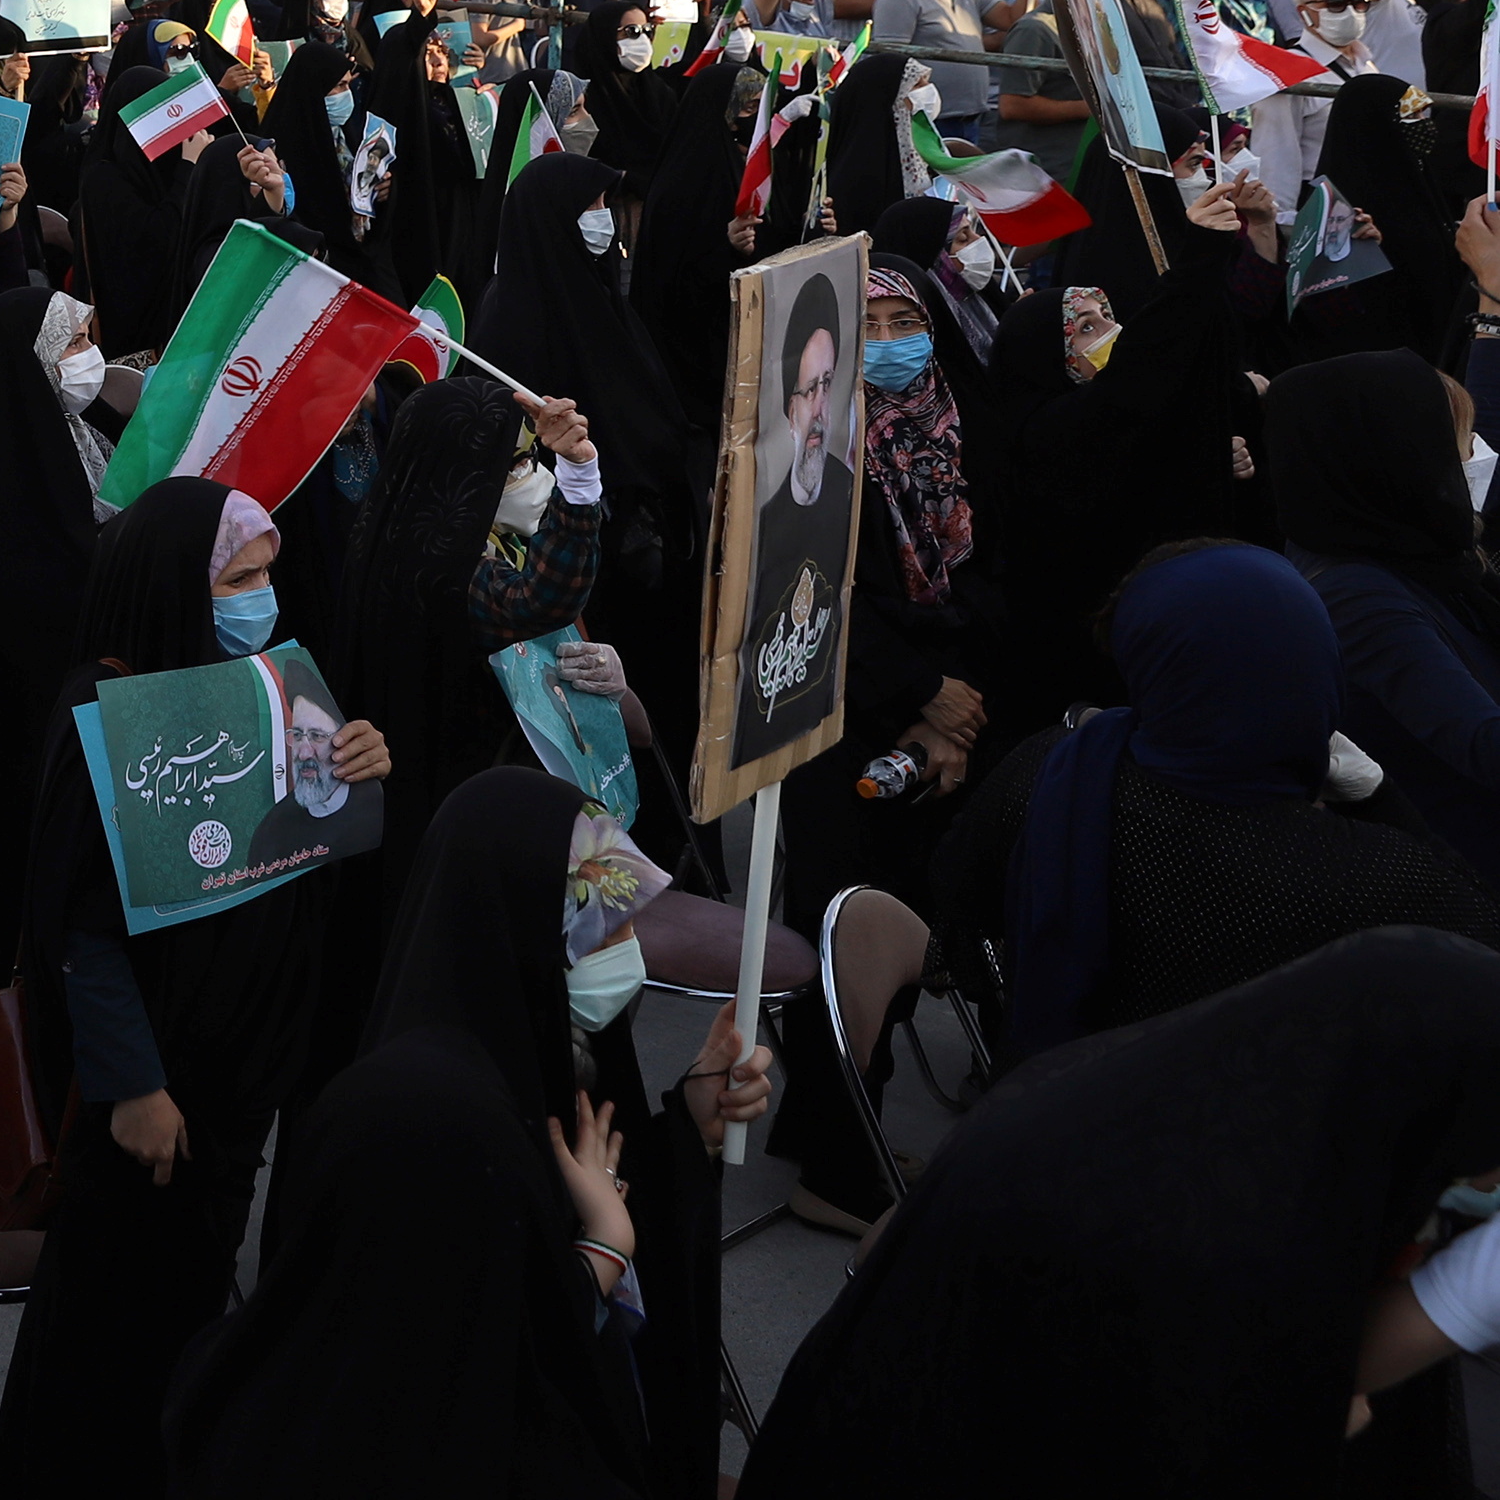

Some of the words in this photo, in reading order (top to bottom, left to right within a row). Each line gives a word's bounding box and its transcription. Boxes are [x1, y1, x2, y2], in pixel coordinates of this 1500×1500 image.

[125, 735, 163, 807] رئیسی
[155, 730, 230, 817] ابراهیم
[289, 848, 312, 867] حامیان
[312, 844, 330, 857] ستاد
[226, 866, 249, 885] استان
[265, 857, 289, 875] مردمی
[201, 872, 227, 890] تهران
